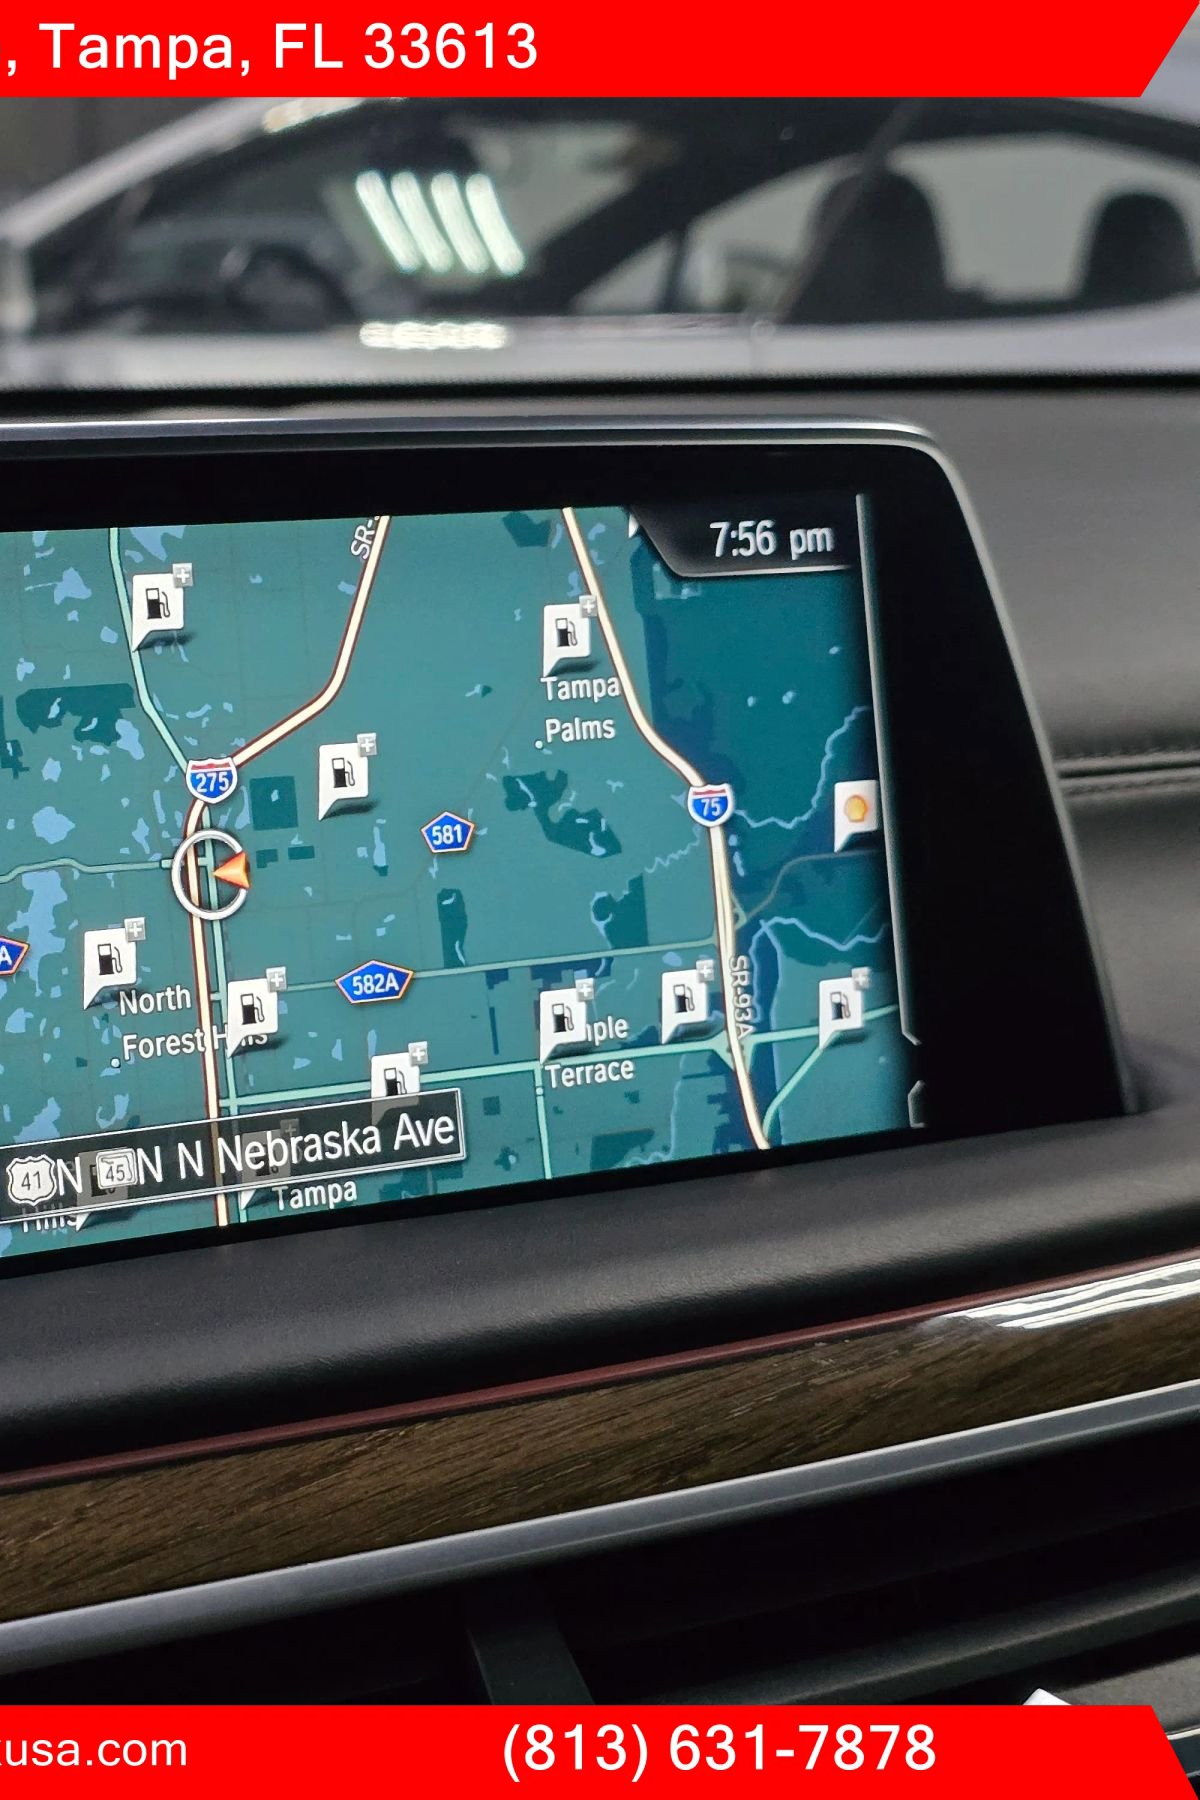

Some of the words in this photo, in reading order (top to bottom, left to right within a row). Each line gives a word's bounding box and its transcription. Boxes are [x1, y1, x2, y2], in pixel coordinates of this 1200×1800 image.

[709, 519, 777, 557] 7:56
[789, 527, 835, 560] pm
[540, 676, 621, 703] Tampa
[545, 716, 616, 743] Palms
[195, 771, 230, 793] 275
[701, 797, 721, 817] 75
[431, 823, 463, 846] 581
[352, 972, 400, 996] 582A
[730, 954, 757, 1041] SR-93A
[118, 984, 192, 1016] North
[122, 1027, 206, 1061] Forest
[544, 1060, 635, 1089] Terrace
[20, 1170, 42, 1191] 41
[56, 1156, 84, 1196] N
[105, 1164, 126, 1183] 45
[136, 1145, 164, 1185] N
[177, 1139, 205, 1180] N
[217, 1119, 383, 1174] Nebraska
[393, 1111, 456, 1151] Ave
[271, 1180, 358, 1210] Tampa
